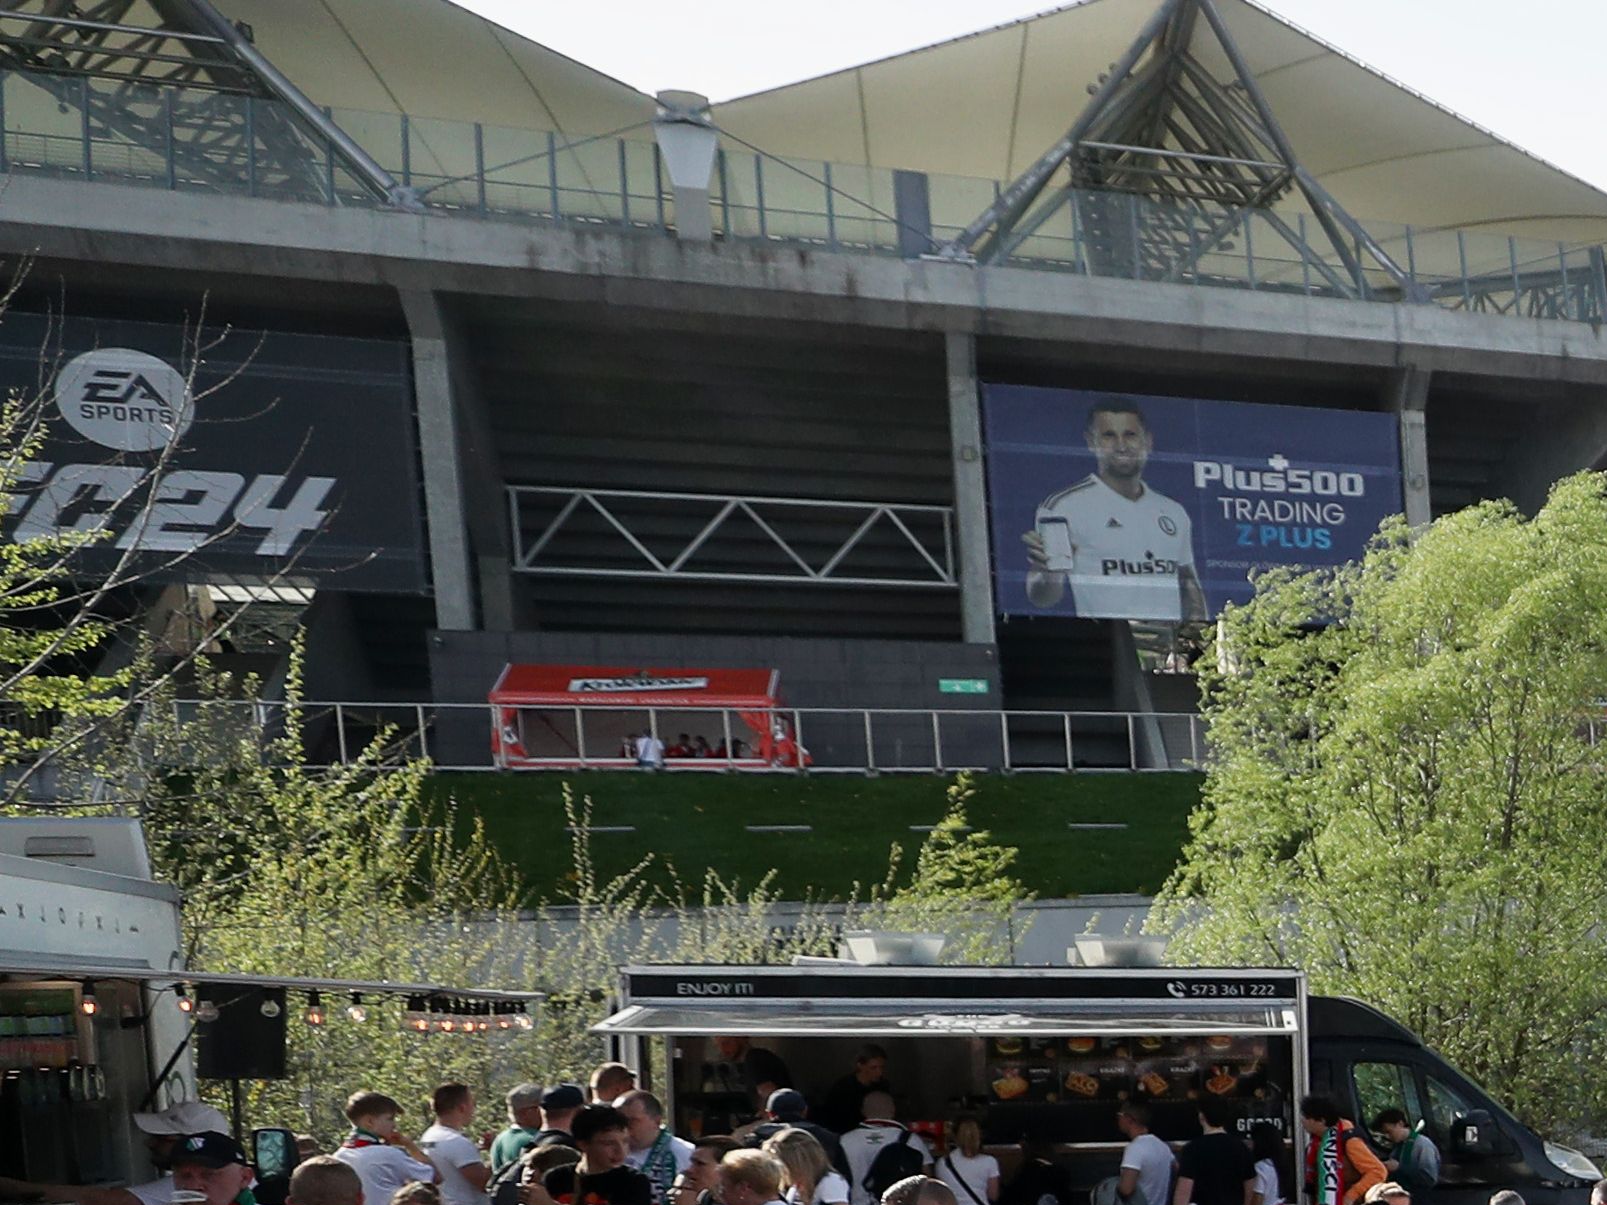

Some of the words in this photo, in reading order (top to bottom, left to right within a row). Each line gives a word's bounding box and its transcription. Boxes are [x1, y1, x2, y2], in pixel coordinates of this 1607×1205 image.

[80, 369, 170, 407] EA
[79, 403, 174, 425] SPORTS
[1193, 459, 1365, 497] Plus500
[1217, 496, 1346, 525] TRADING
[1236, 523, 1253, 547] Z
[1260, 524, 1332, 550] PLUS
[677, 982, 732, 996] ENJOY
[1191, 983, 1217, 996] 573
[1220, 983, 1246, 996] 361
[1249, 983, 1275, 996] 222
